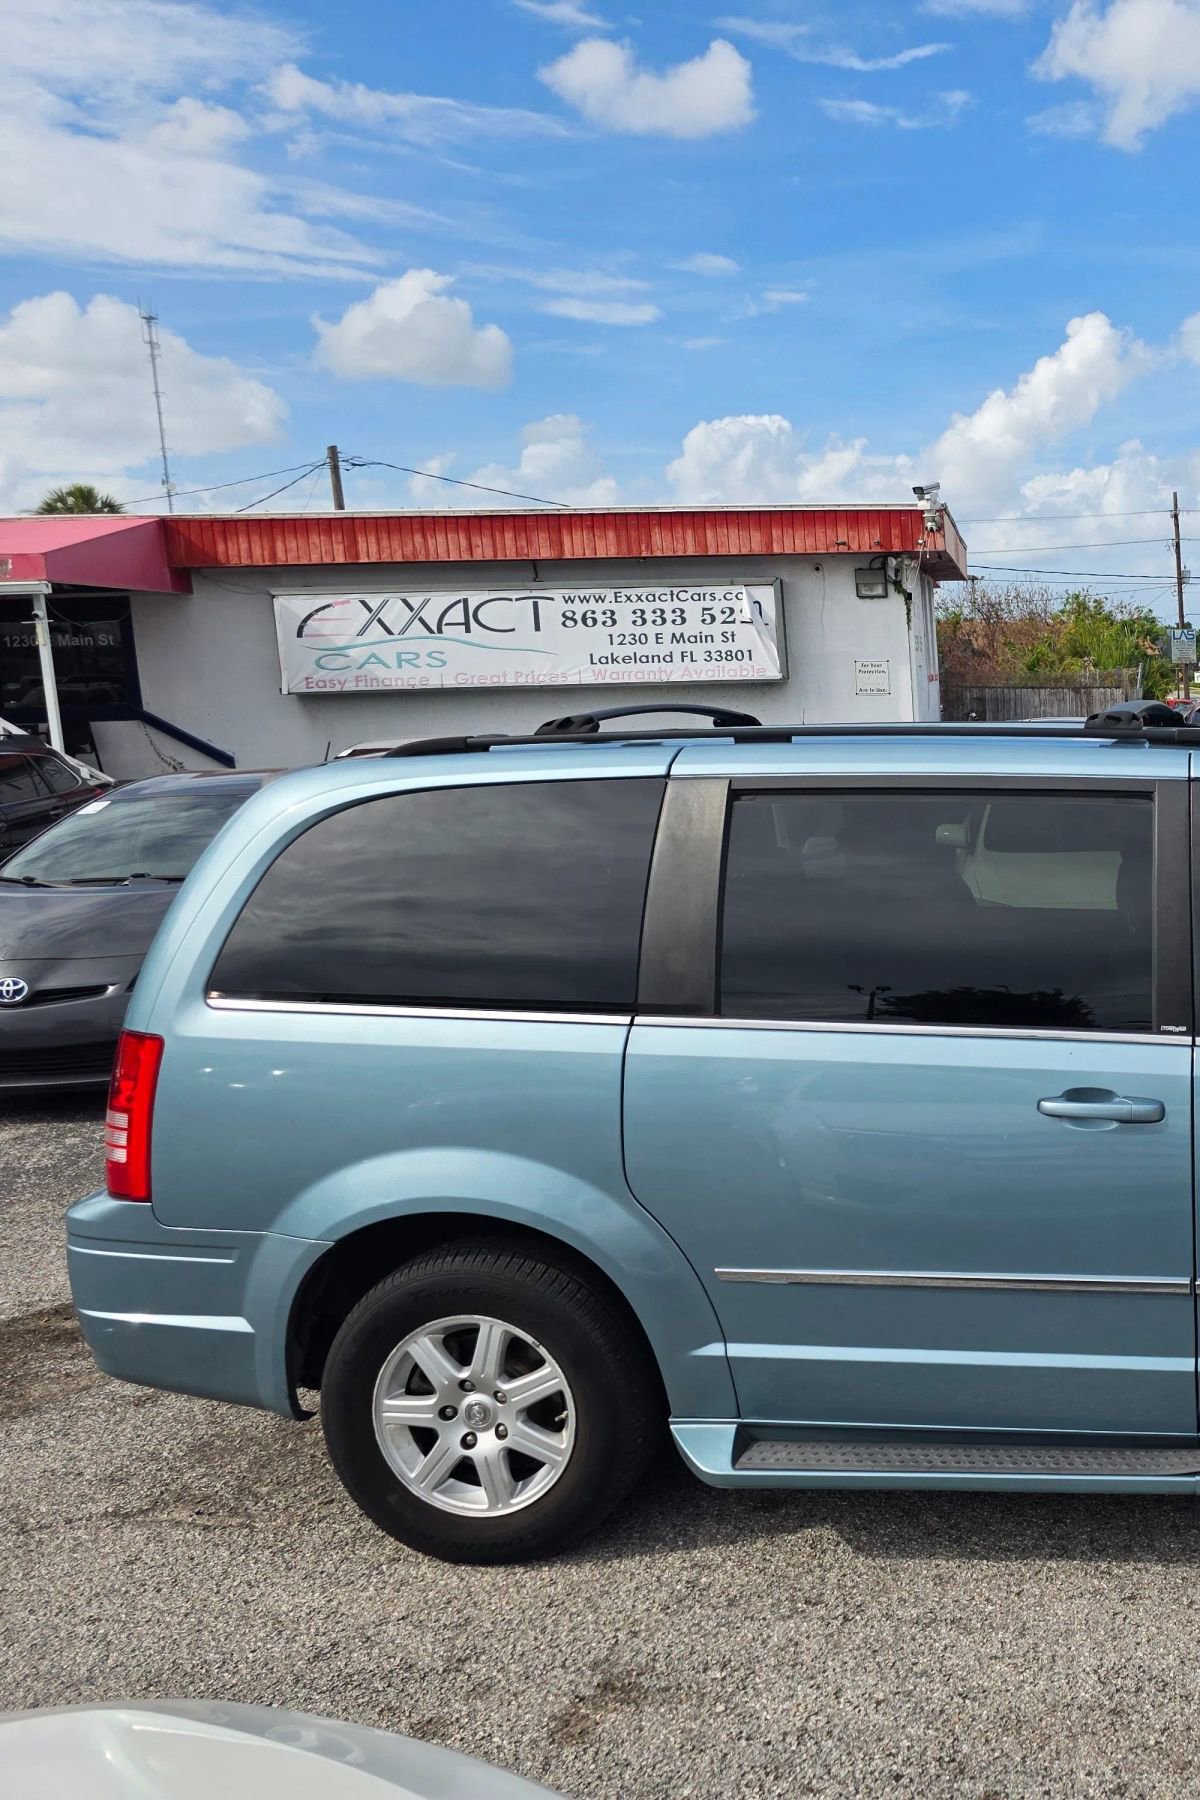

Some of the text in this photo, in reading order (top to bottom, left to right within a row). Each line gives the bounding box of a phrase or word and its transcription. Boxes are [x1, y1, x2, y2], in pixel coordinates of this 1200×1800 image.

[562, 589, 743, 604] www.ExxactCars.co
[297, 596, 554, 638] EXXACT
[561, 608, 617, 628] 863
[631, 607, 687, 627] 333
[57, 634, 94, 647] Main
[98, 633, 115, 646] St
[607, 631, 736, 646] 1230 E Main St
[1173, 630, 1195, 640] LAS
[315, 651, 447, 671] CARS
[590, 649, 753, 665] Lakeland FL 33801
[304, 664, 767, 691] Easy Finance Great Prices Warranty Available
